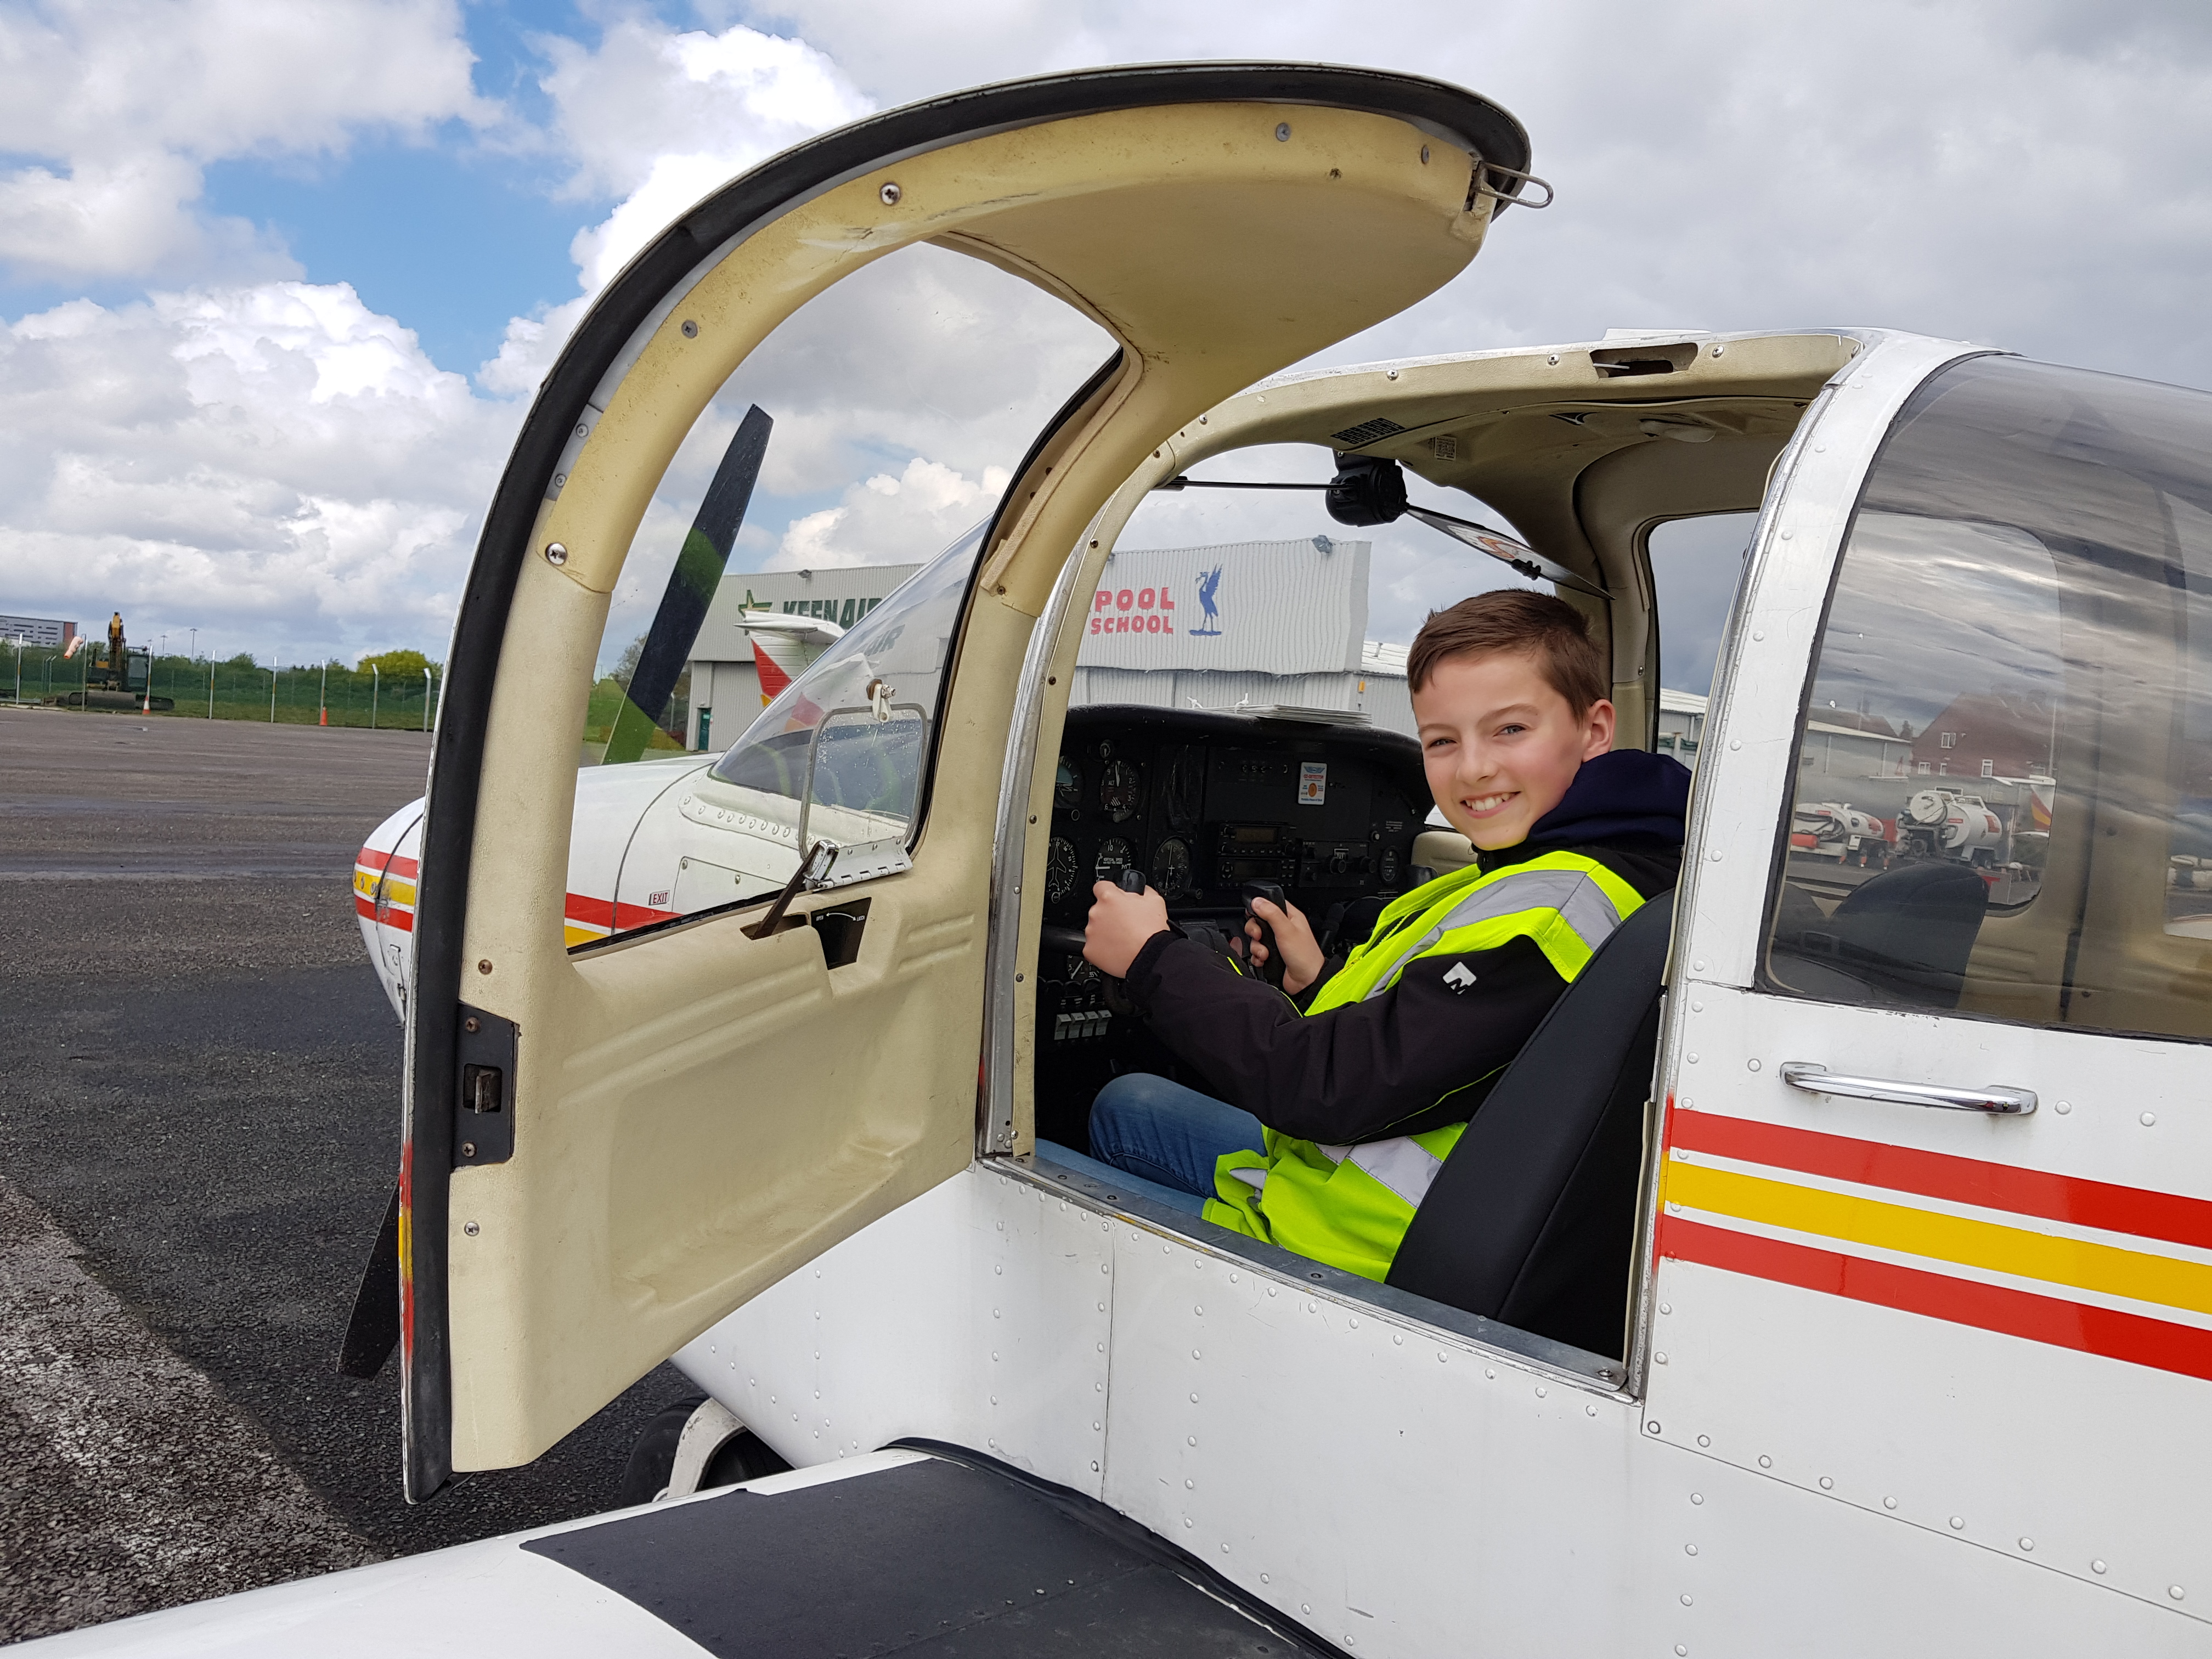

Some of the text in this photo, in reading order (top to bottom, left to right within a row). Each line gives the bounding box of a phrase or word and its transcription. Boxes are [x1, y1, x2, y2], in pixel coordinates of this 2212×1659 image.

[1094, 587, 1175, 612] POOL
[1091, 615, 1173, 635] SCHOOL
[653, 892, 668, 904] EXIT
